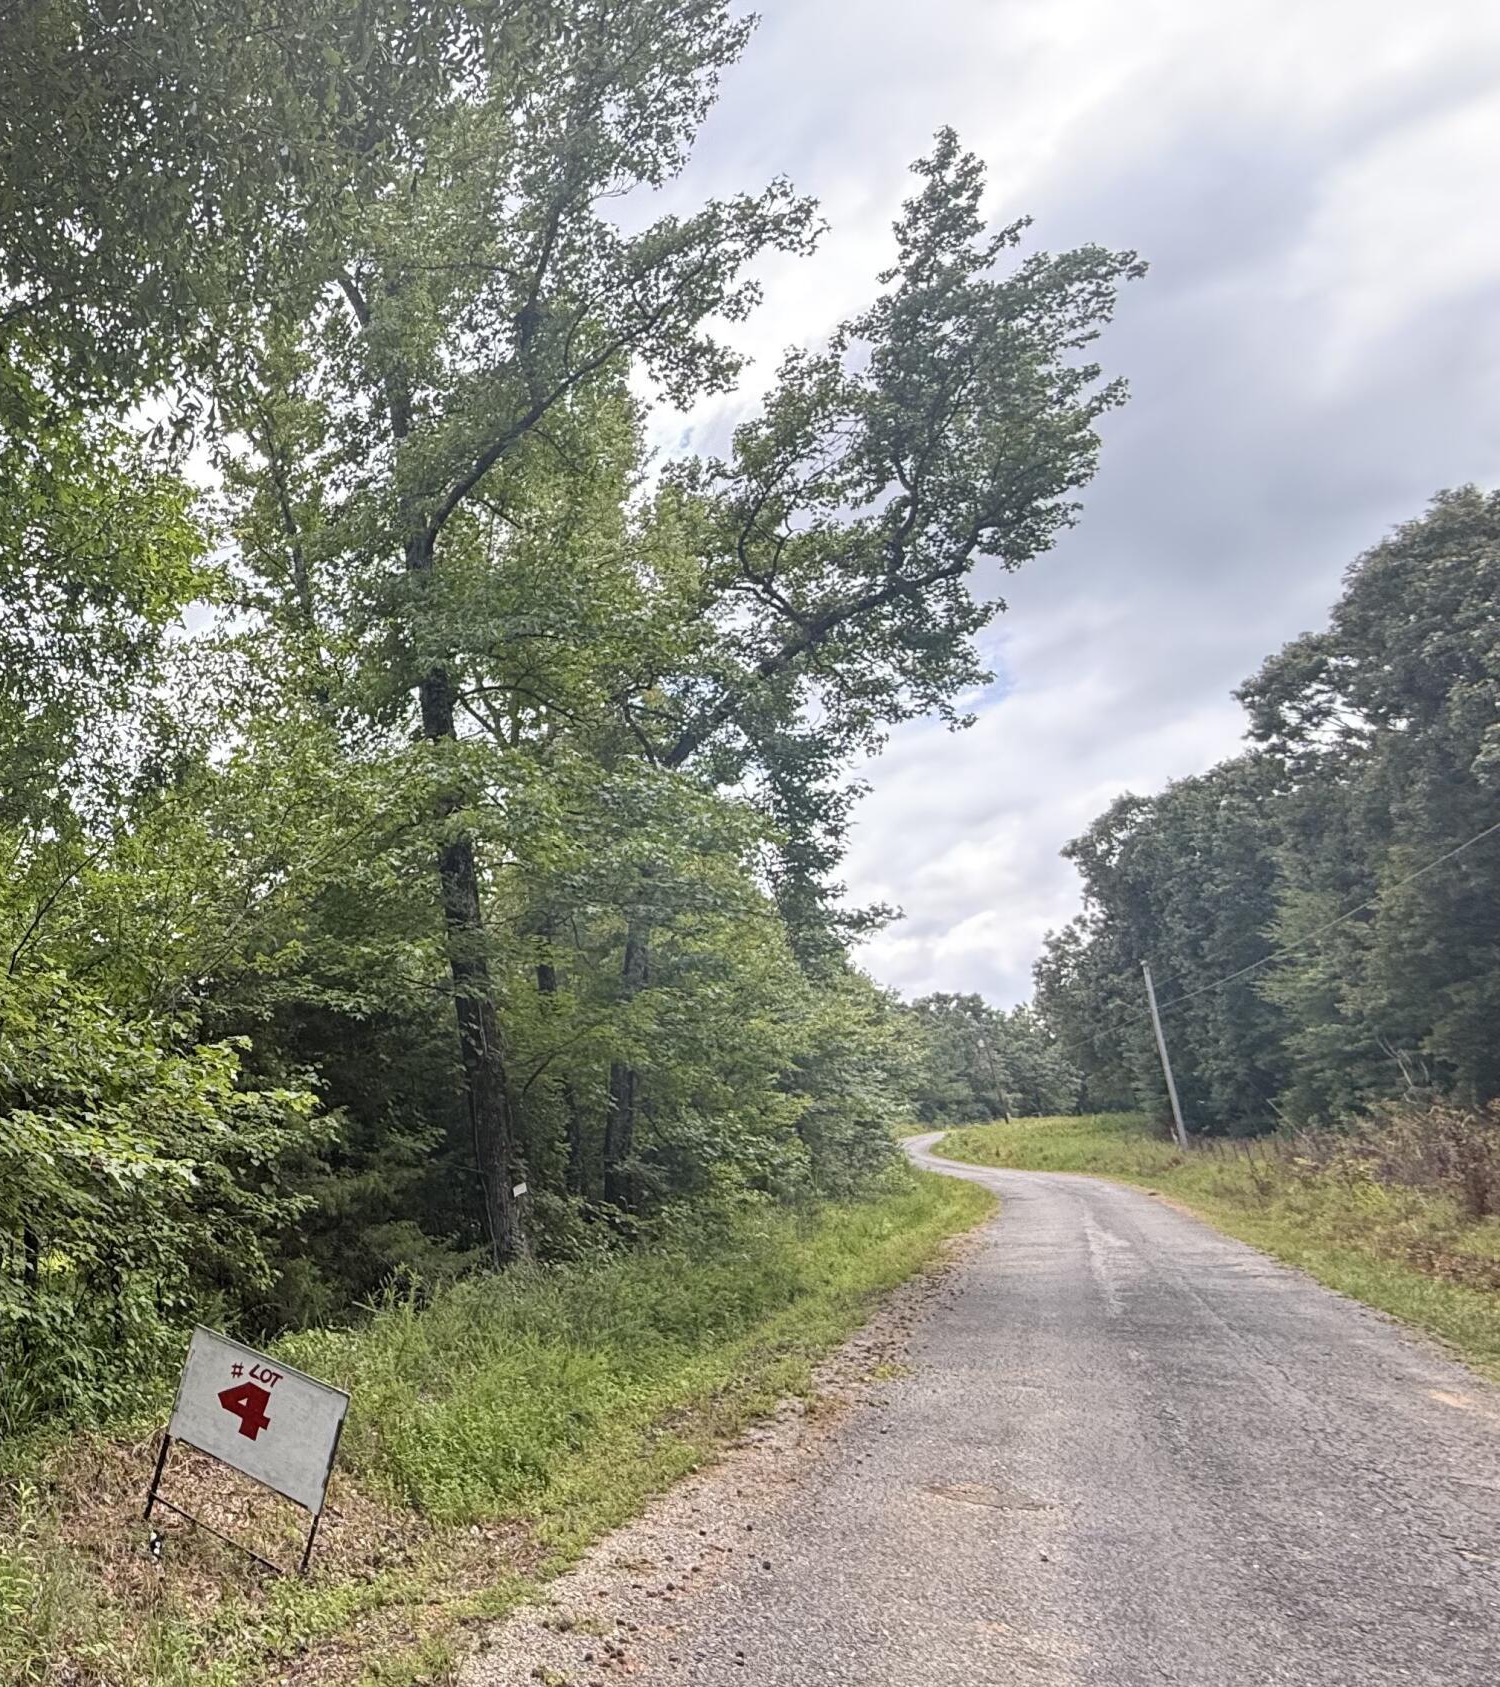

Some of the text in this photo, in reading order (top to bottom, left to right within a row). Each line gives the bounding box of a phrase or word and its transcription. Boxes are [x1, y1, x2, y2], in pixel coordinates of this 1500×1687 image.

[231, 1362, 283, 1388] # LOT
[217, 1381, 271, 1441] 4
